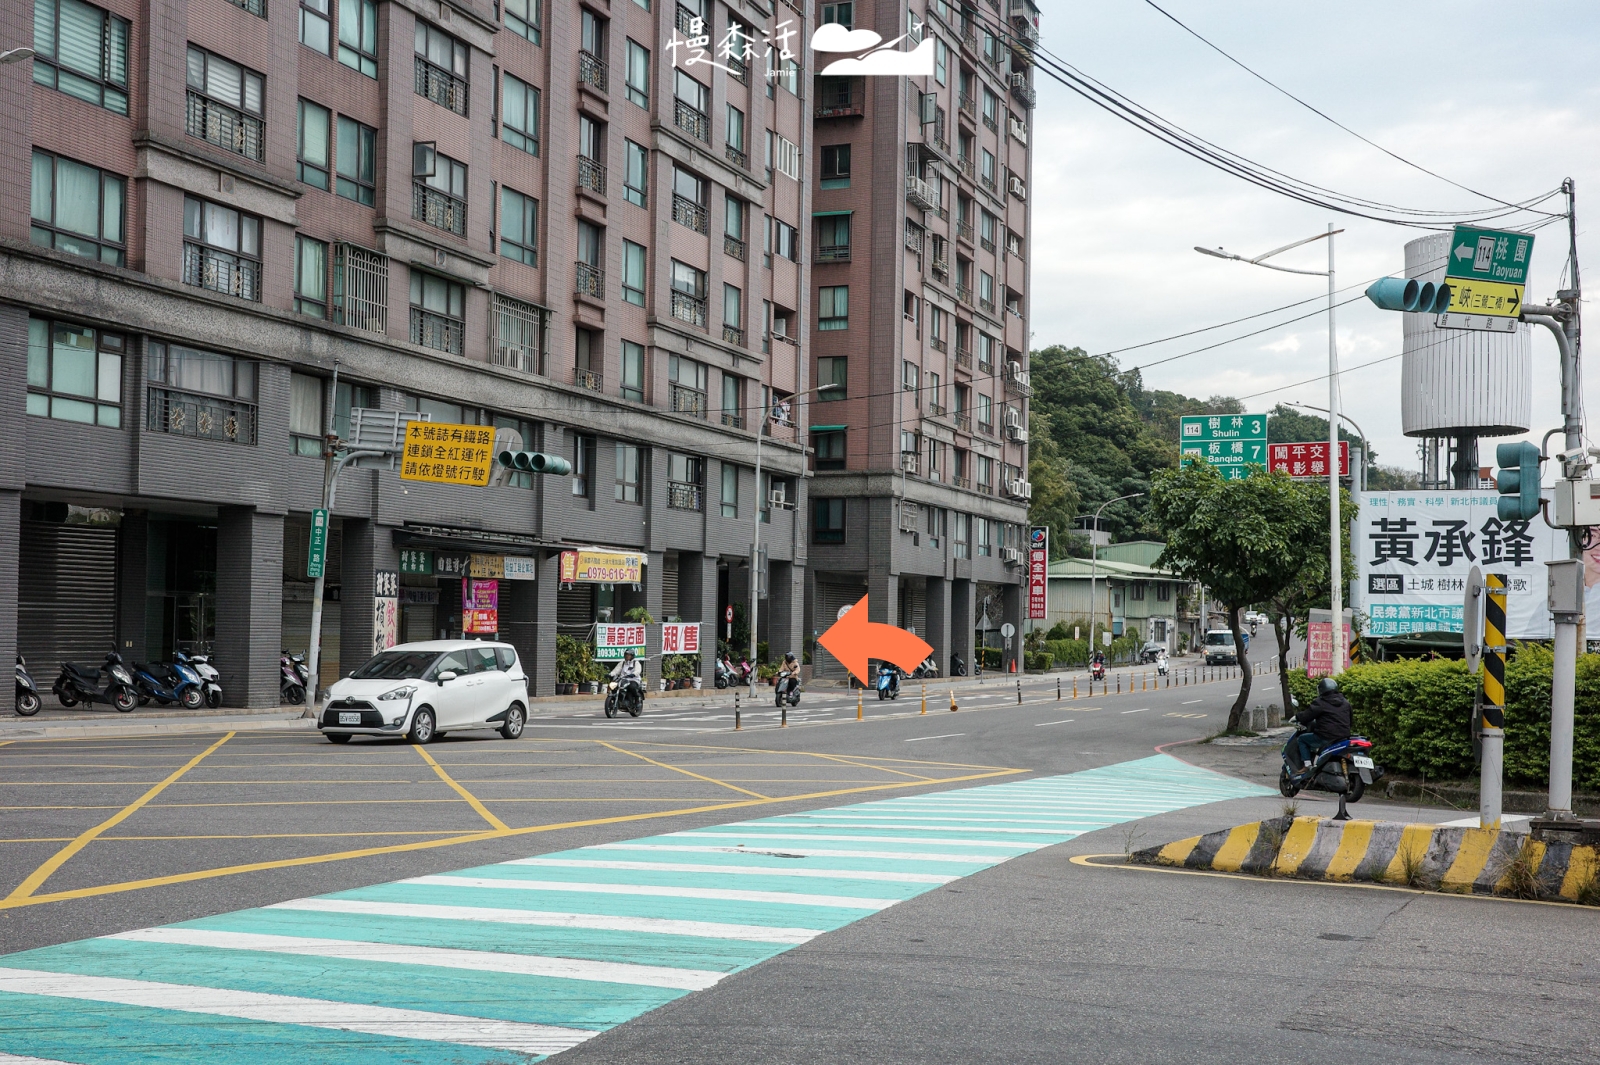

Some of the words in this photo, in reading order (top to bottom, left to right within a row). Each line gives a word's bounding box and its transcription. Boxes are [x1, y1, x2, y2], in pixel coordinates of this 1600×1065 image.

[1477, 246, 1492, 262] 114
[1495, 237, 1528, 263] 桃園
[1492, 262, 1523, 280] Taoyuan
[1186, 426, 1199, 434] 114
[1208, 416, 1243, 430] 樹林
[1251, 420, 1261, 434] 3
[1212, 429, 1240, 438] Shulin
[410, 426, 490, 445] 本號誌有鐵路
[407, 443, 488, 463] 連鎖全紅運作
[1208, 442, 1243, 454] 板橋
[1251, 446, 1261, 459] 7
[1208, 455, 1243, 463] Banqiao
[405, 461, 486, 481] 請依燈號行駛
[1368, 517, 1535, 567] 黃承鋒
[563, 552, 575, 579] 售
[1372, 578, 1399, 591] 選區
[1407, 578, 1434, 591] 土城
[1437, 578, 1464, 591] 樹林
[607, 626, 644, 646] 黃金店面
